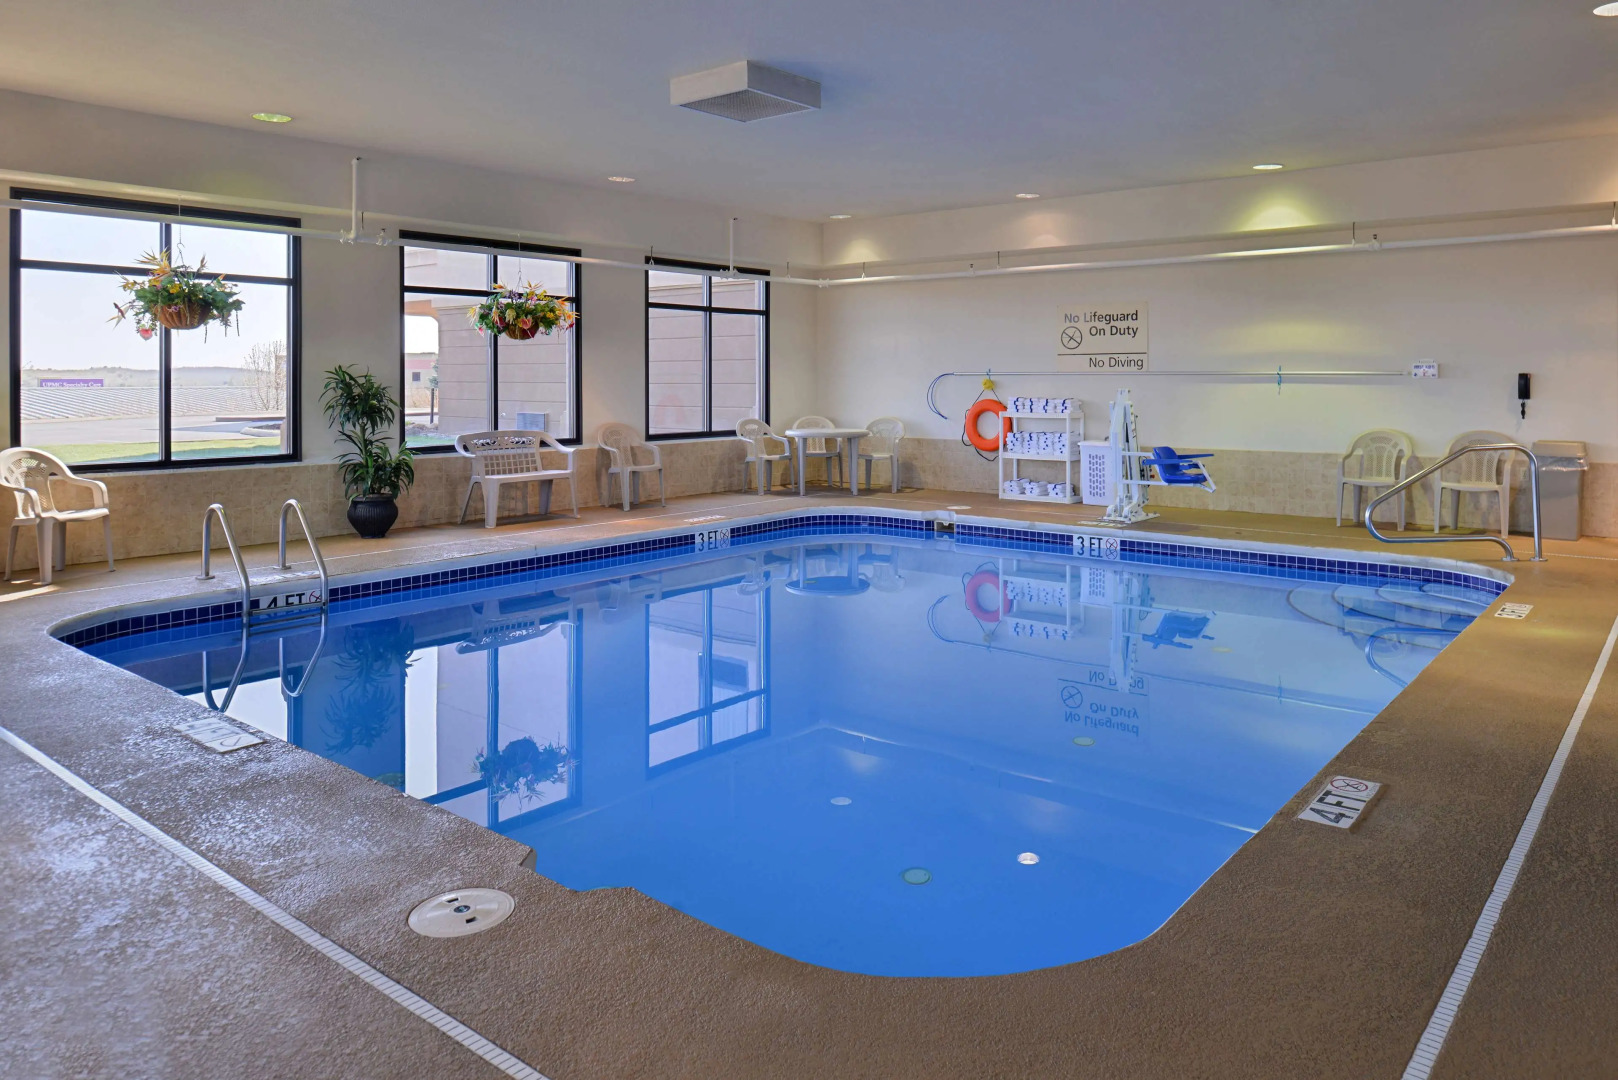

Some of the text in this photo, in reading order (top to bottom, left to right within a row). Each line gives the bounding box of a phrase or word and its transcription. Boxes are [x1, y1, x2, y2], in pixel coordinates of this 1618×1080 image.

[1064, 309, 1139, 325] No Lifeguard
[1089, 325, 1139, 338] On Duty
[1088, 356, 1144, 371] No Diving
